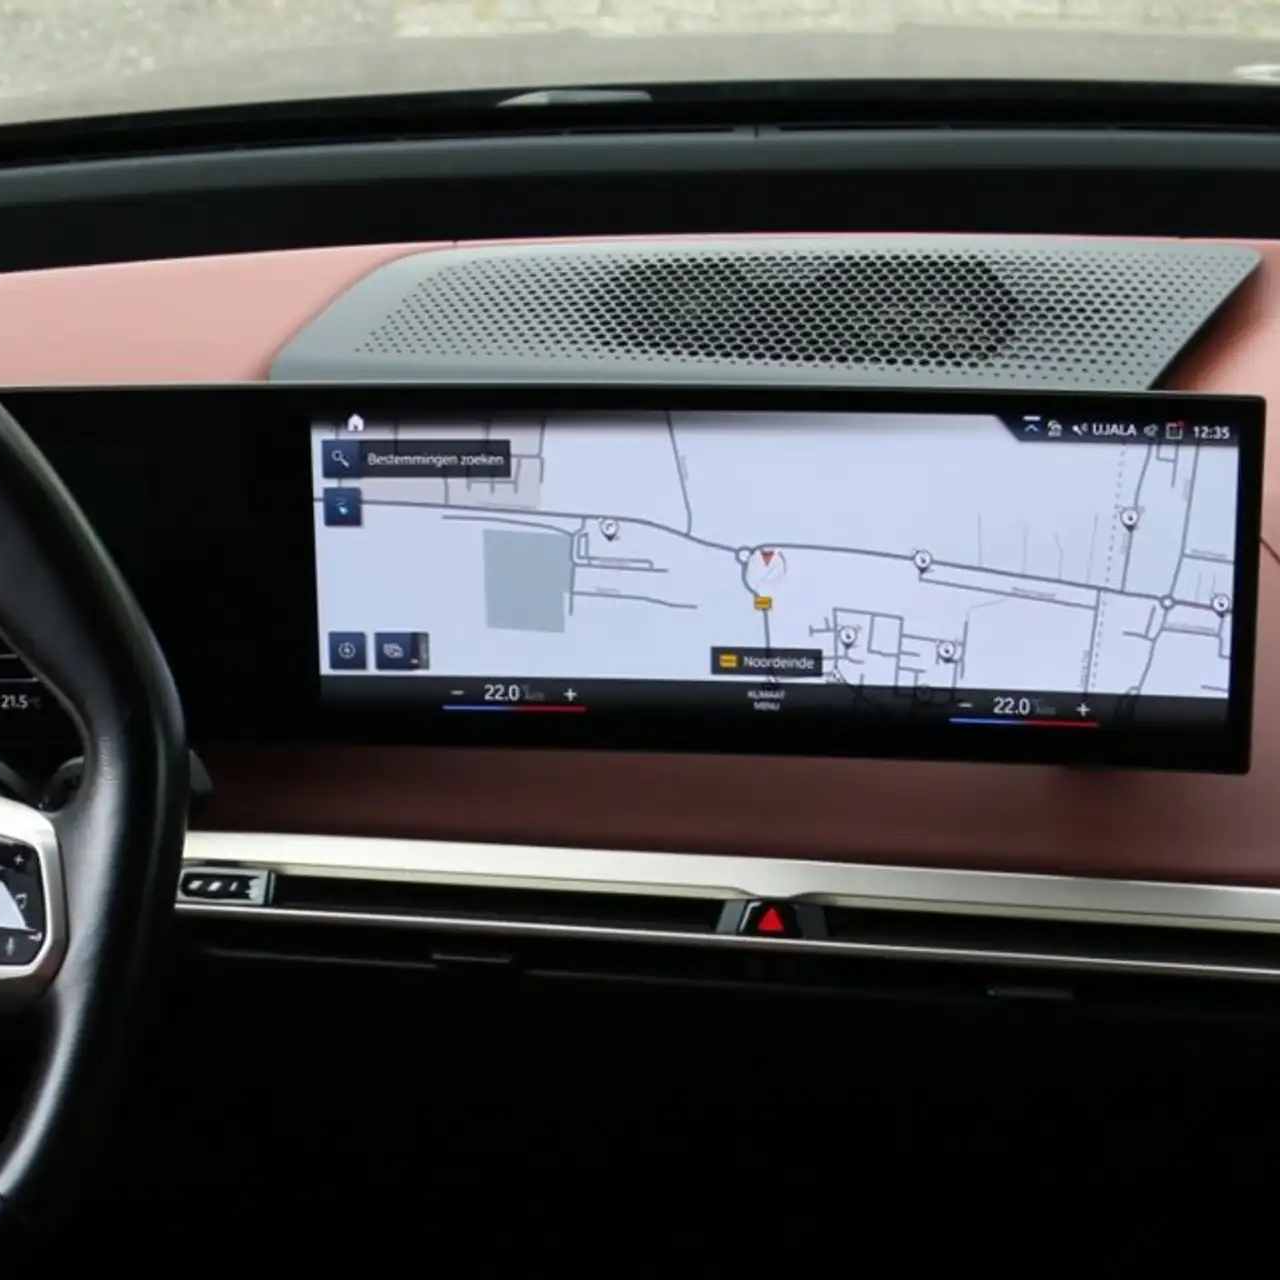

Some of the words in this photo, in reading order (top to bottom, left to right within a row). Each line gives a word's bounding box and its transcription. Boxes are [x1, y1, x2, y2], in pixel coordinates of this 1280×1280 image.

[1192, 426, 1230, 439] 12:35
[367, 452, 457, 467] Bestemmingen
[460, 453, 504, 466] zoeken
[743, 656, 815, 669] Noordeinde
[484, 684, 520, 701] 22.0
[993, 697, 1031, 715] 22.0
